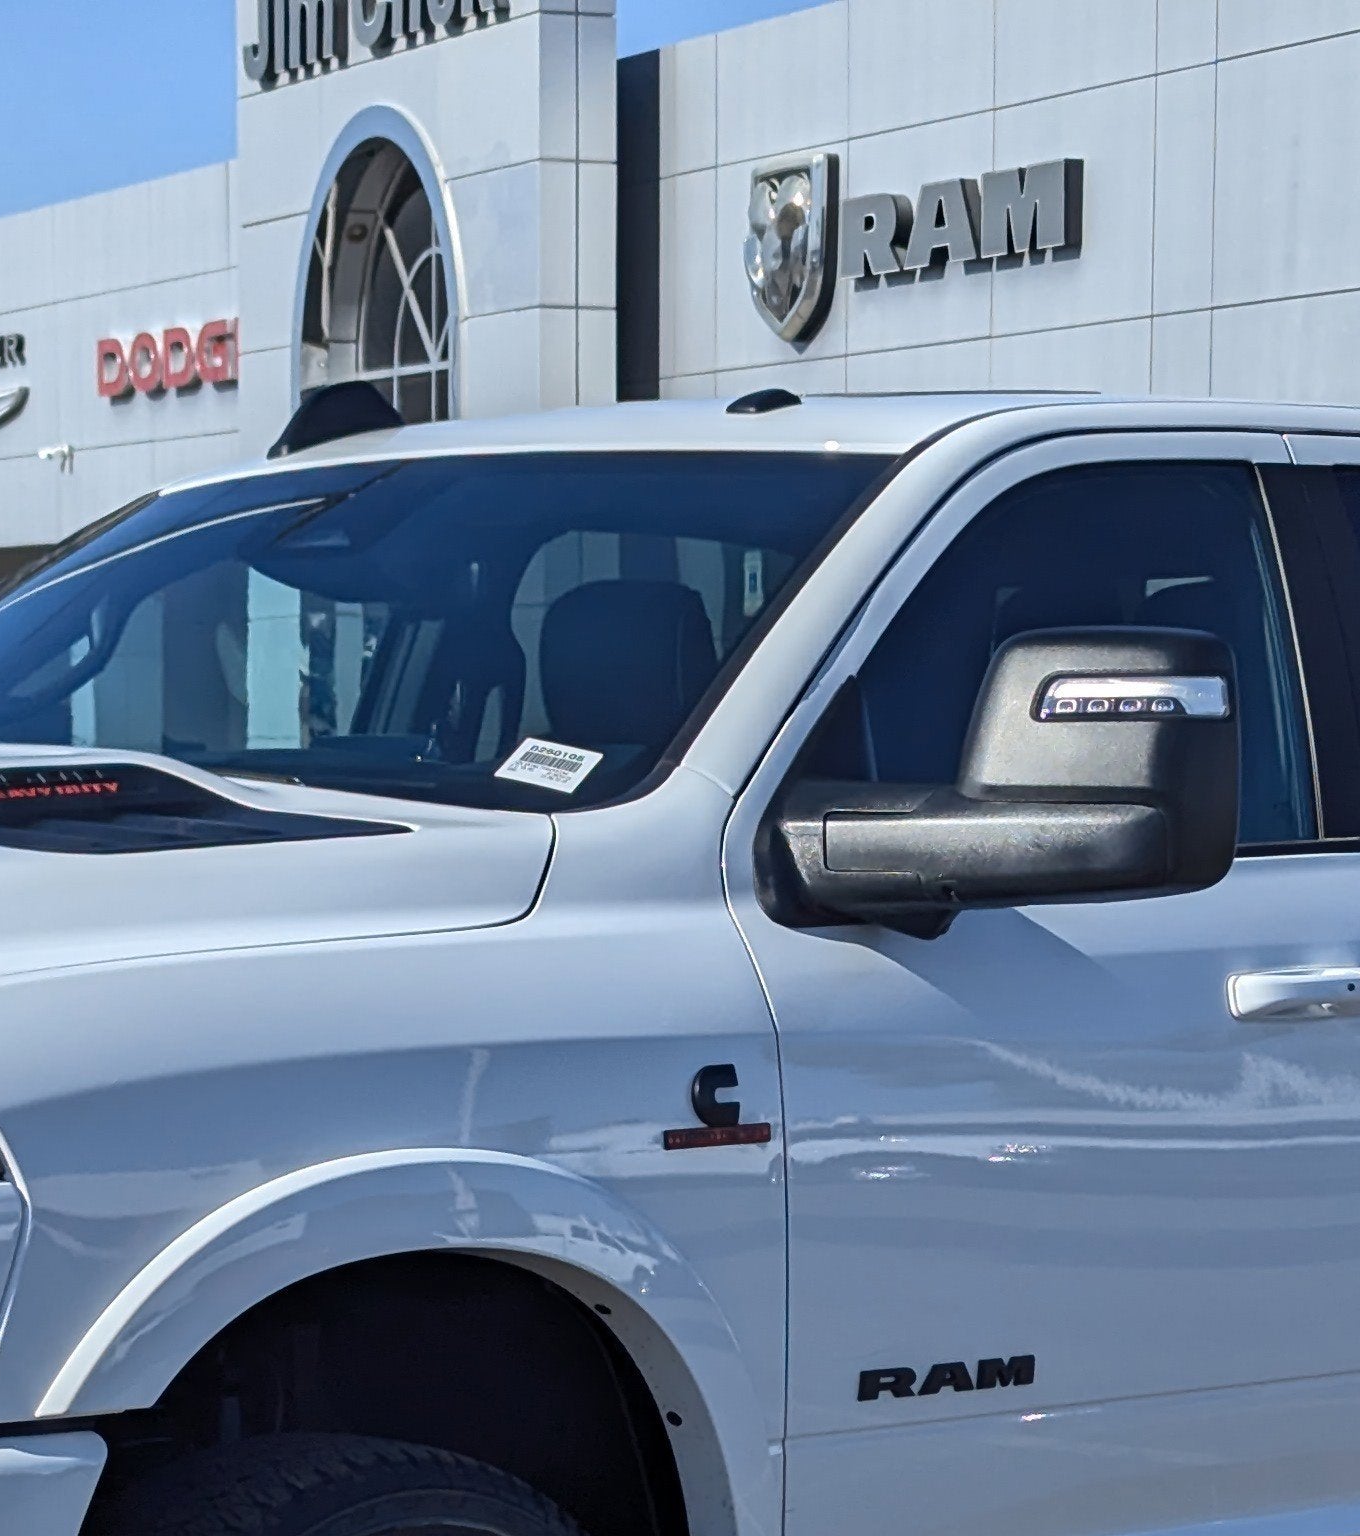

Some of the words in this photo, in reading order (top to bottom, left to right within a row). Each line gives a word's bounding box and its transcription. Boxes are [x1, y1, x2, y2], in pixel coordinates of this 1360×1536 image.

[841, 159, 1082, 280] RAM
[96, 317, 239, 398] DODG
[857, 1354, 1036, 1402] RAM
